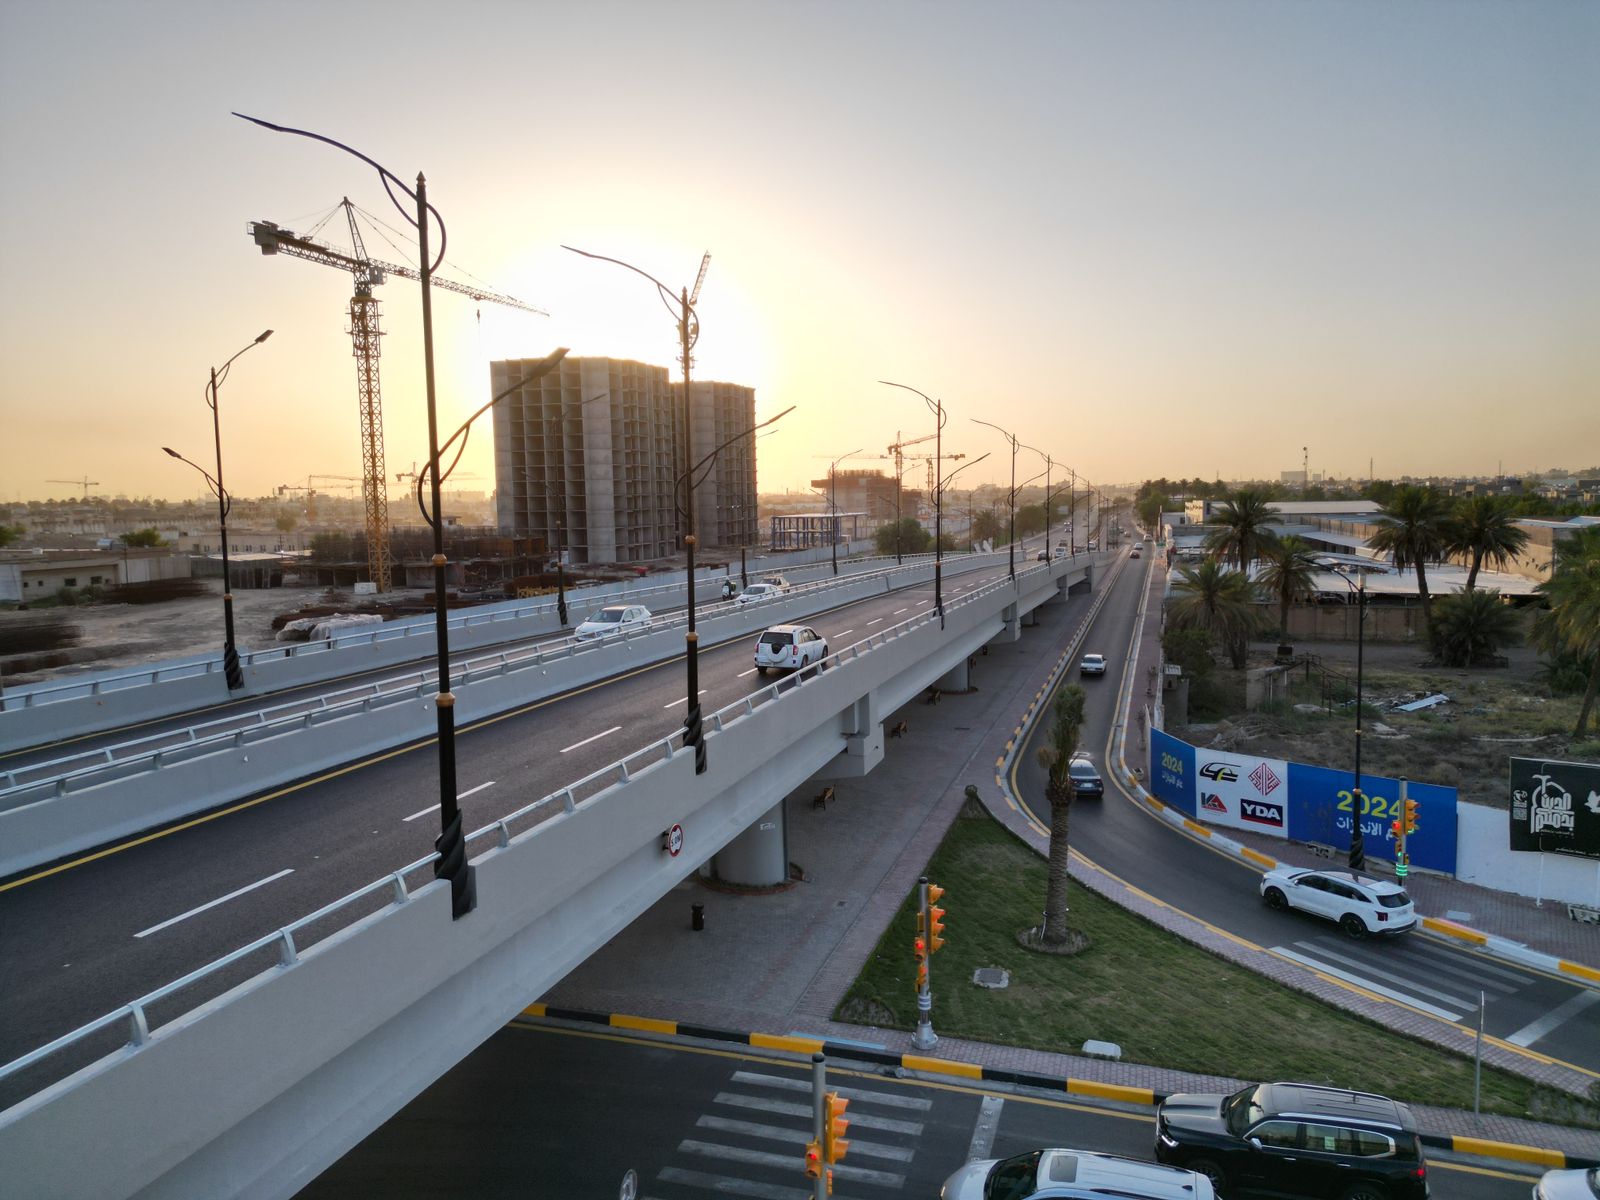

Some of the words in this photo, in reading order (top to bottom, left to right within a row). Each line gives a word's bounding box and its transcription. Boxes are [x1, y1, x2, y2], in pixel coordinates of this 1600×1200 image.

[1161, 752, 1183, 775] 2024
[1242, 802, 1281, 820] YDA
[1336, 816, 1382, 836] الانجزات
